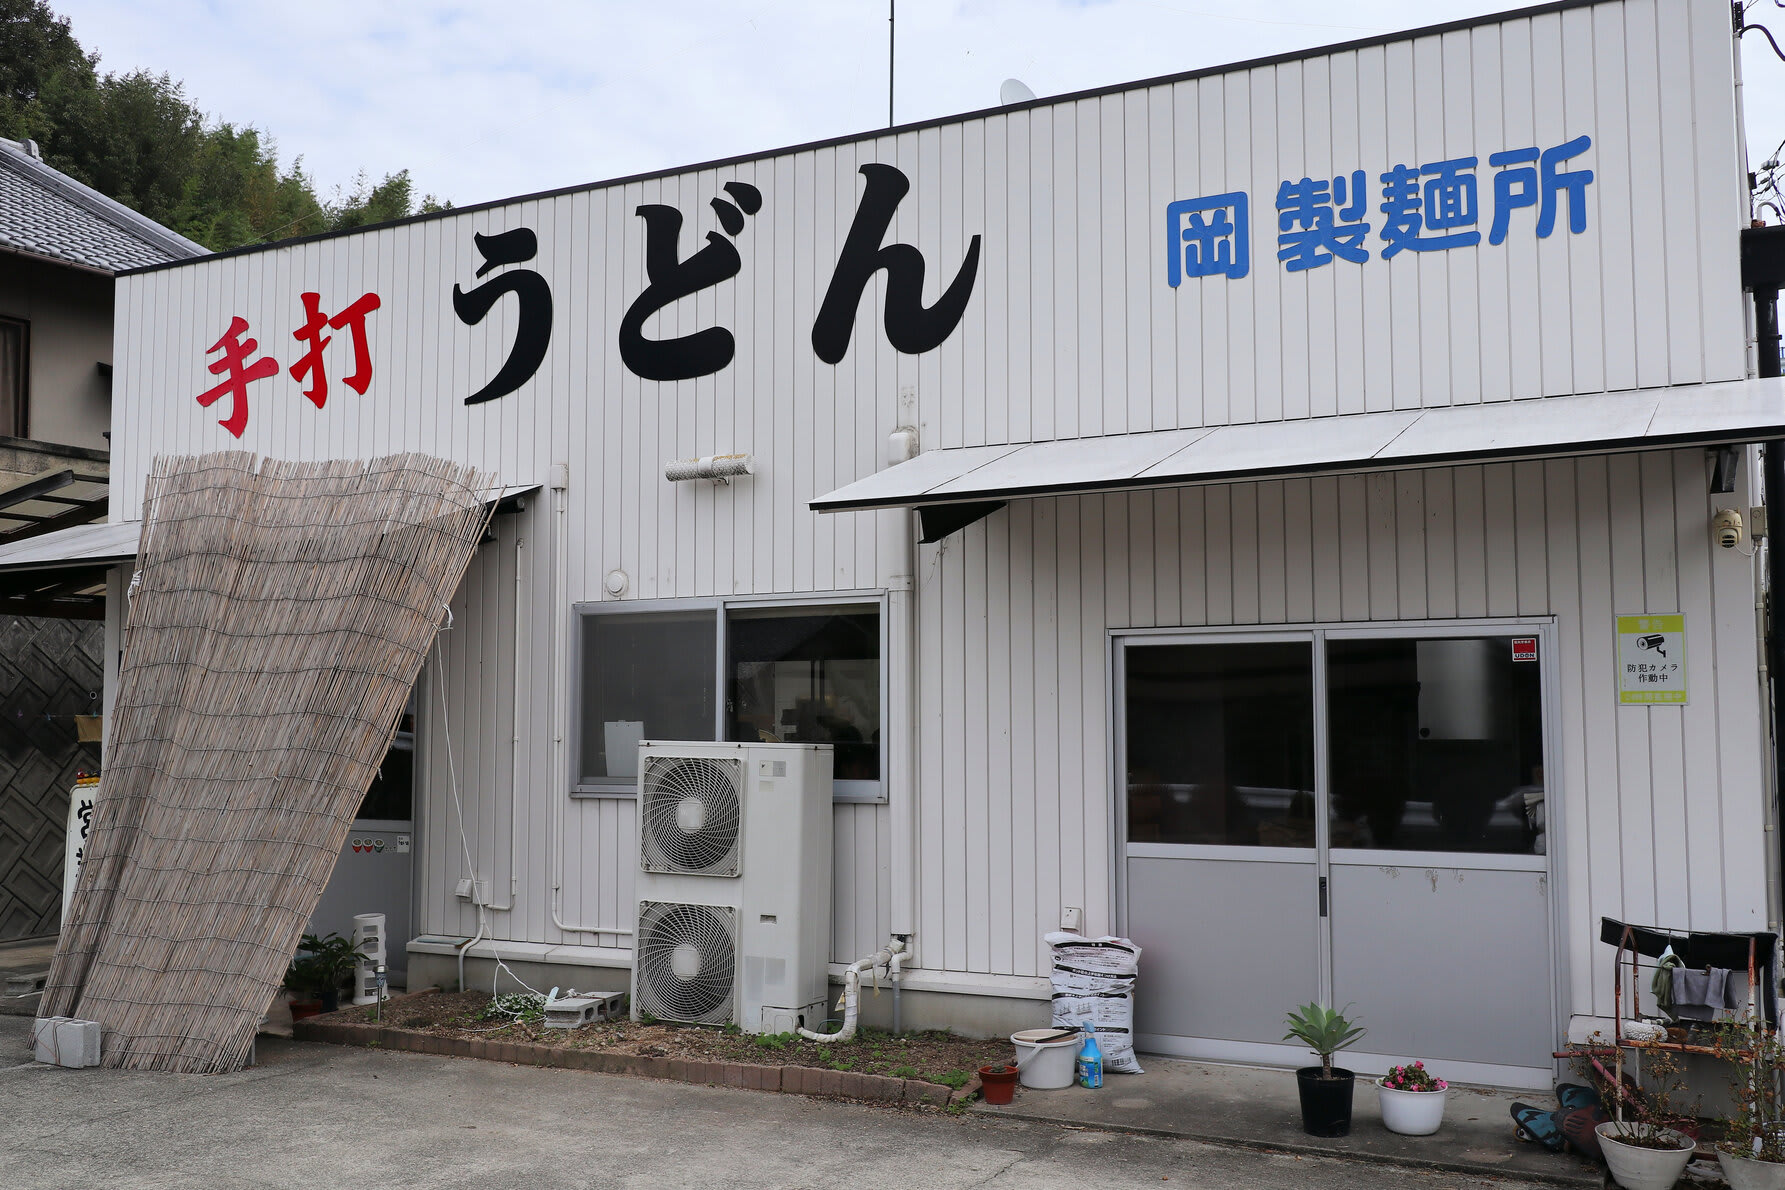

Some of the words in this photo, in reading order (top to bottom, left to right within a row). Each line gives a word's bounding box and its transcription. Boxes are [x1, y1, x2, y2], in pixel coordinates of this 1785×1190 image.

[1166, 135, 1594, 288] 岡製麺所
[196, 292, 381, 439] 手打
[453, 163, 981, 406] うどん
[1627, 663, 1678, 673] 防犯カメラ
[1638, 673, 1668, 683] 作動中
